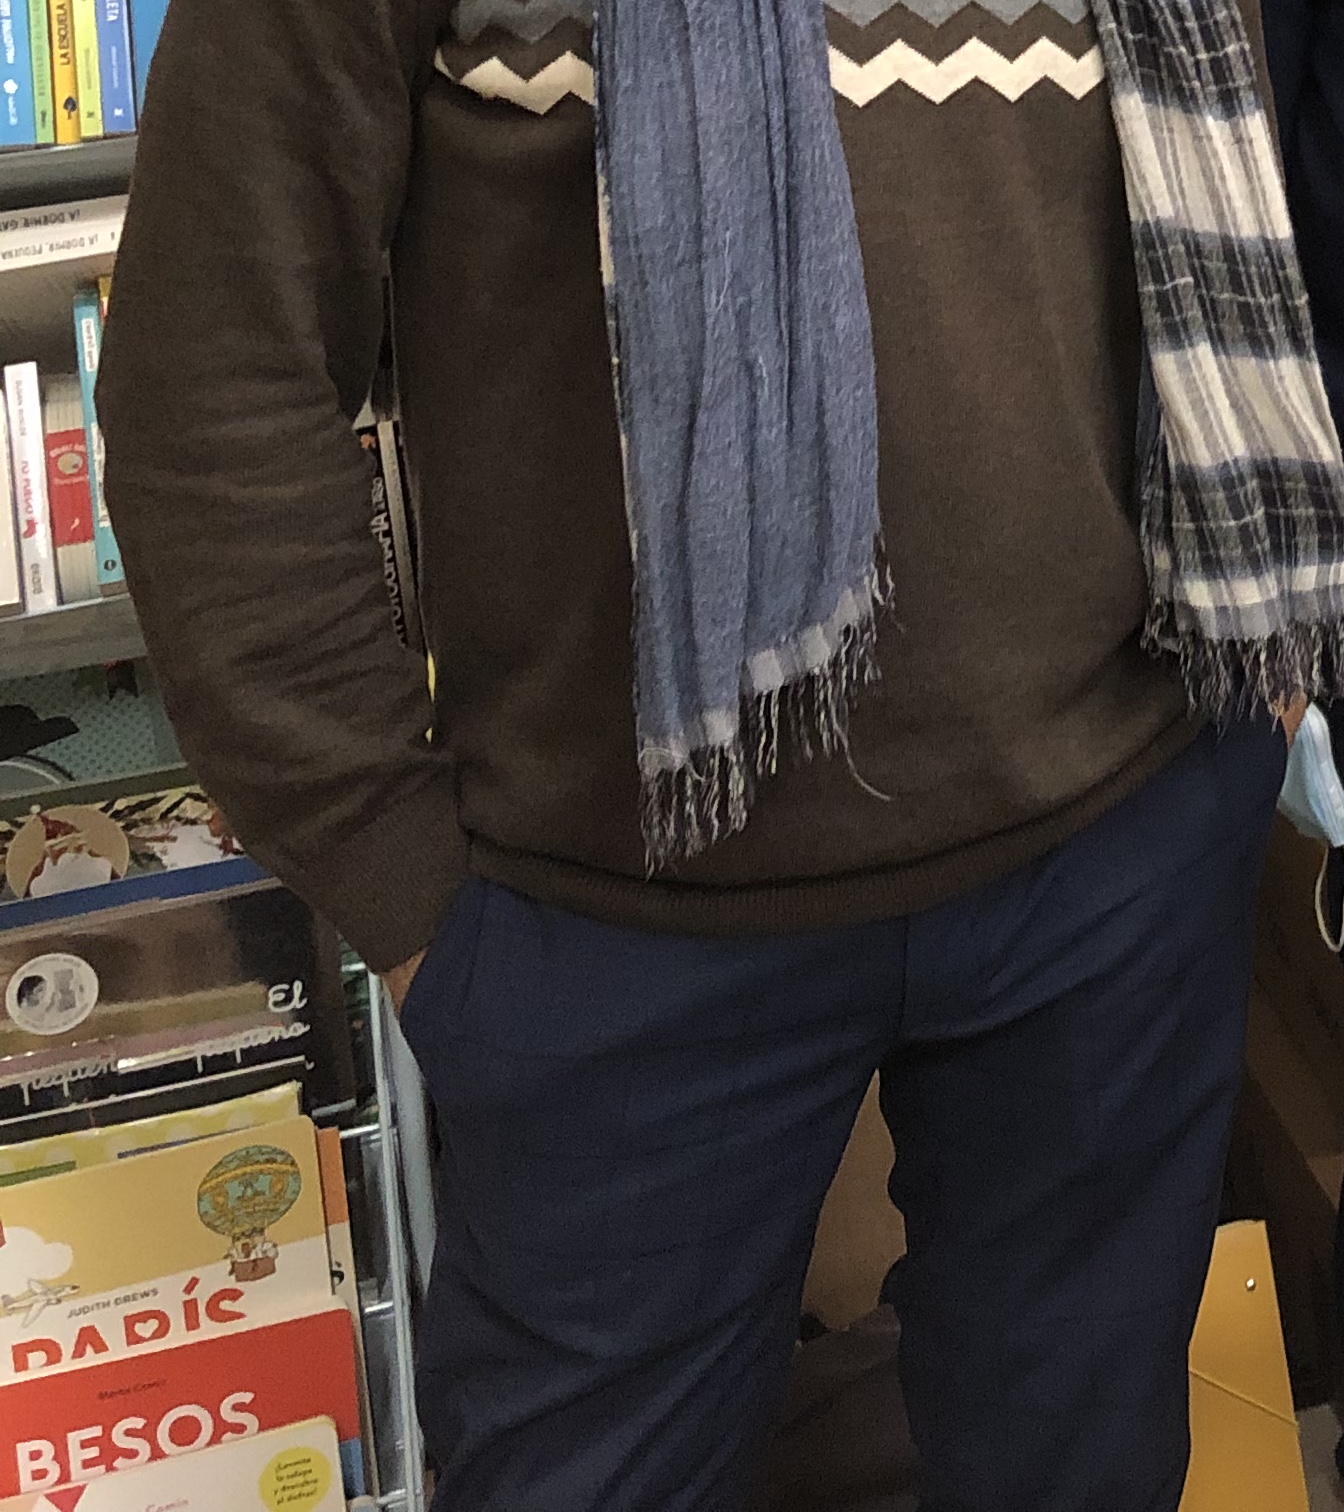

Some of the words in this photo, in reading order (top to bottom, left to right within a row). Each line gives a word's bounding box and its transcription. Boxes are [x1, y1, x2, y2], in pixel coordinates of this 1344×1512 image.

[57, 3, 71, 50] ESCUELA
[60, 52, 73, 66] LA
[266, 980, 308, 1013] El
[66, 1301, 113, 1320] JUDITH
[15, 1391, 260, 1495] BESOS
